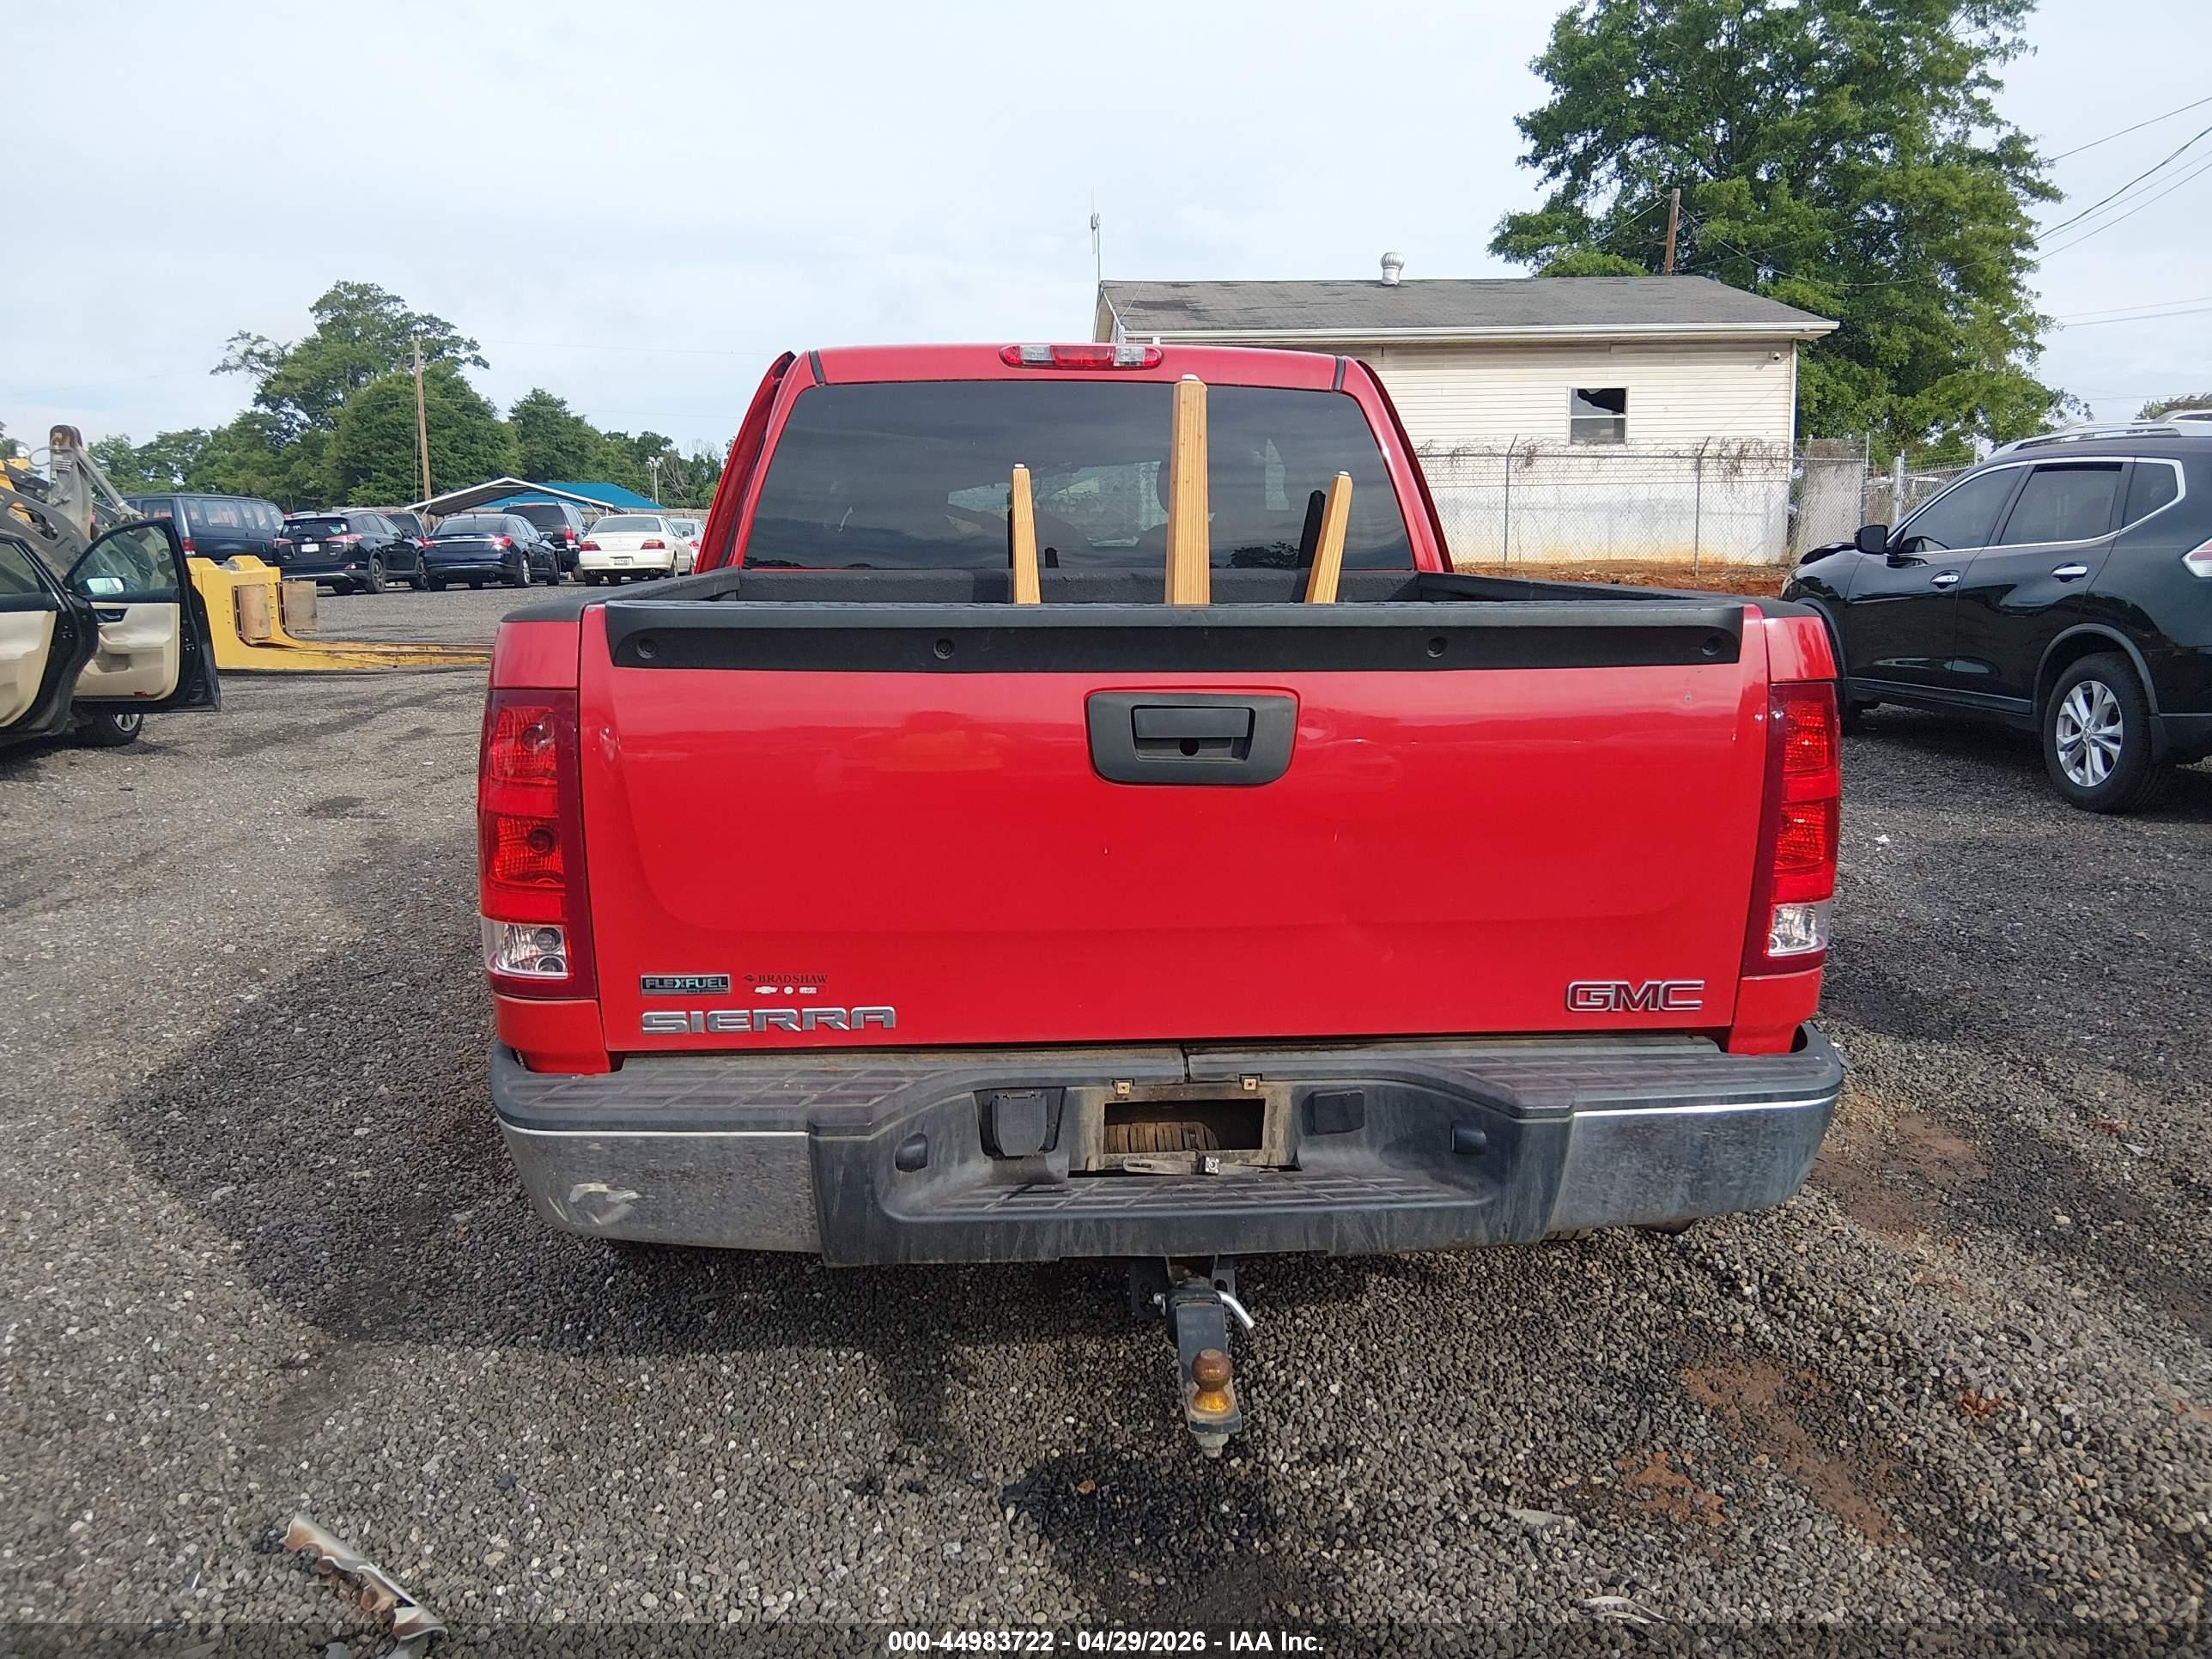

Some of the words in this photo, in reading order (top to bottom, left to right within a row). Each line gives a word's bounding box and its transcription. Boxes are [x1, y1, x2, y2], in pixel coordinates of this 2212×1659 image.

[645, 977, 727, 988] FLEXFUEL
[757, 975, 828, 983] BRADSHAW
[1567, 980, 1705, 1012] GMC
[641, 1006, 896, 1034] SIERRA
